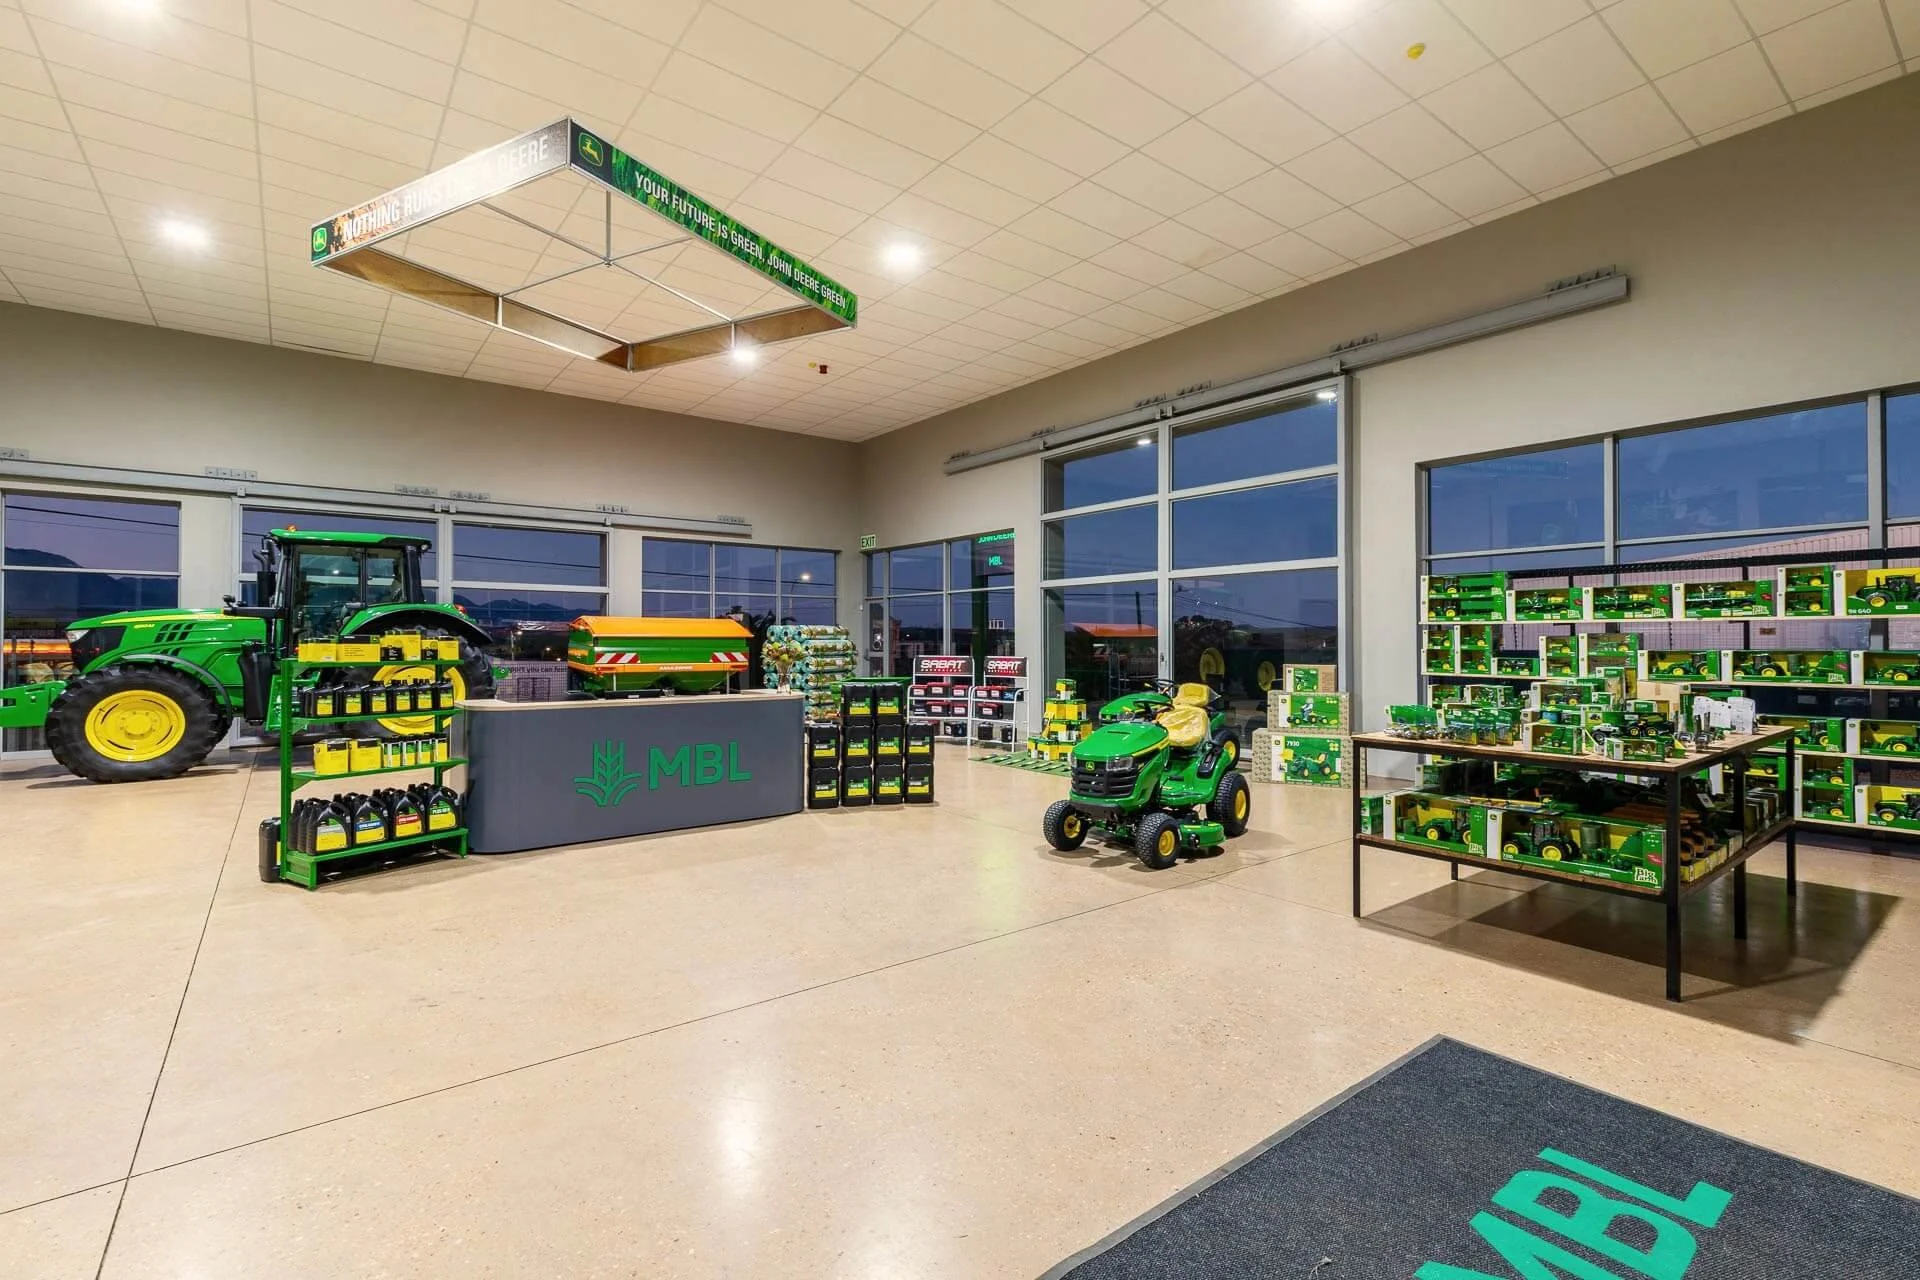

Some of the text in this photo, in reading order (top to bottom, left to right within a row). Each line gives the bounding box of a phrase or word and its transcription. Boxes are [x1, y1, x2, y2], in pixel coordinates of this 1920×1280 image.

[344, 200, 401, 241] NOTHING
[403, 181, 444, 217] RUNS
[497, 134, 550, 179] DEERE
[634, 170, 847, 309] YOUR FUTURE IS GREEN, JOHN DEERE GREEN
[861, 535, 876, 548] EXIT
[988, 555, 1003, 566] MBL
[920, 660, 966, 669] SABAT
[987, 660, 1022, 670] SABAT
[648, 741, 753, 791] MBL
[1414, 1147, 1734, 1280] MBL
